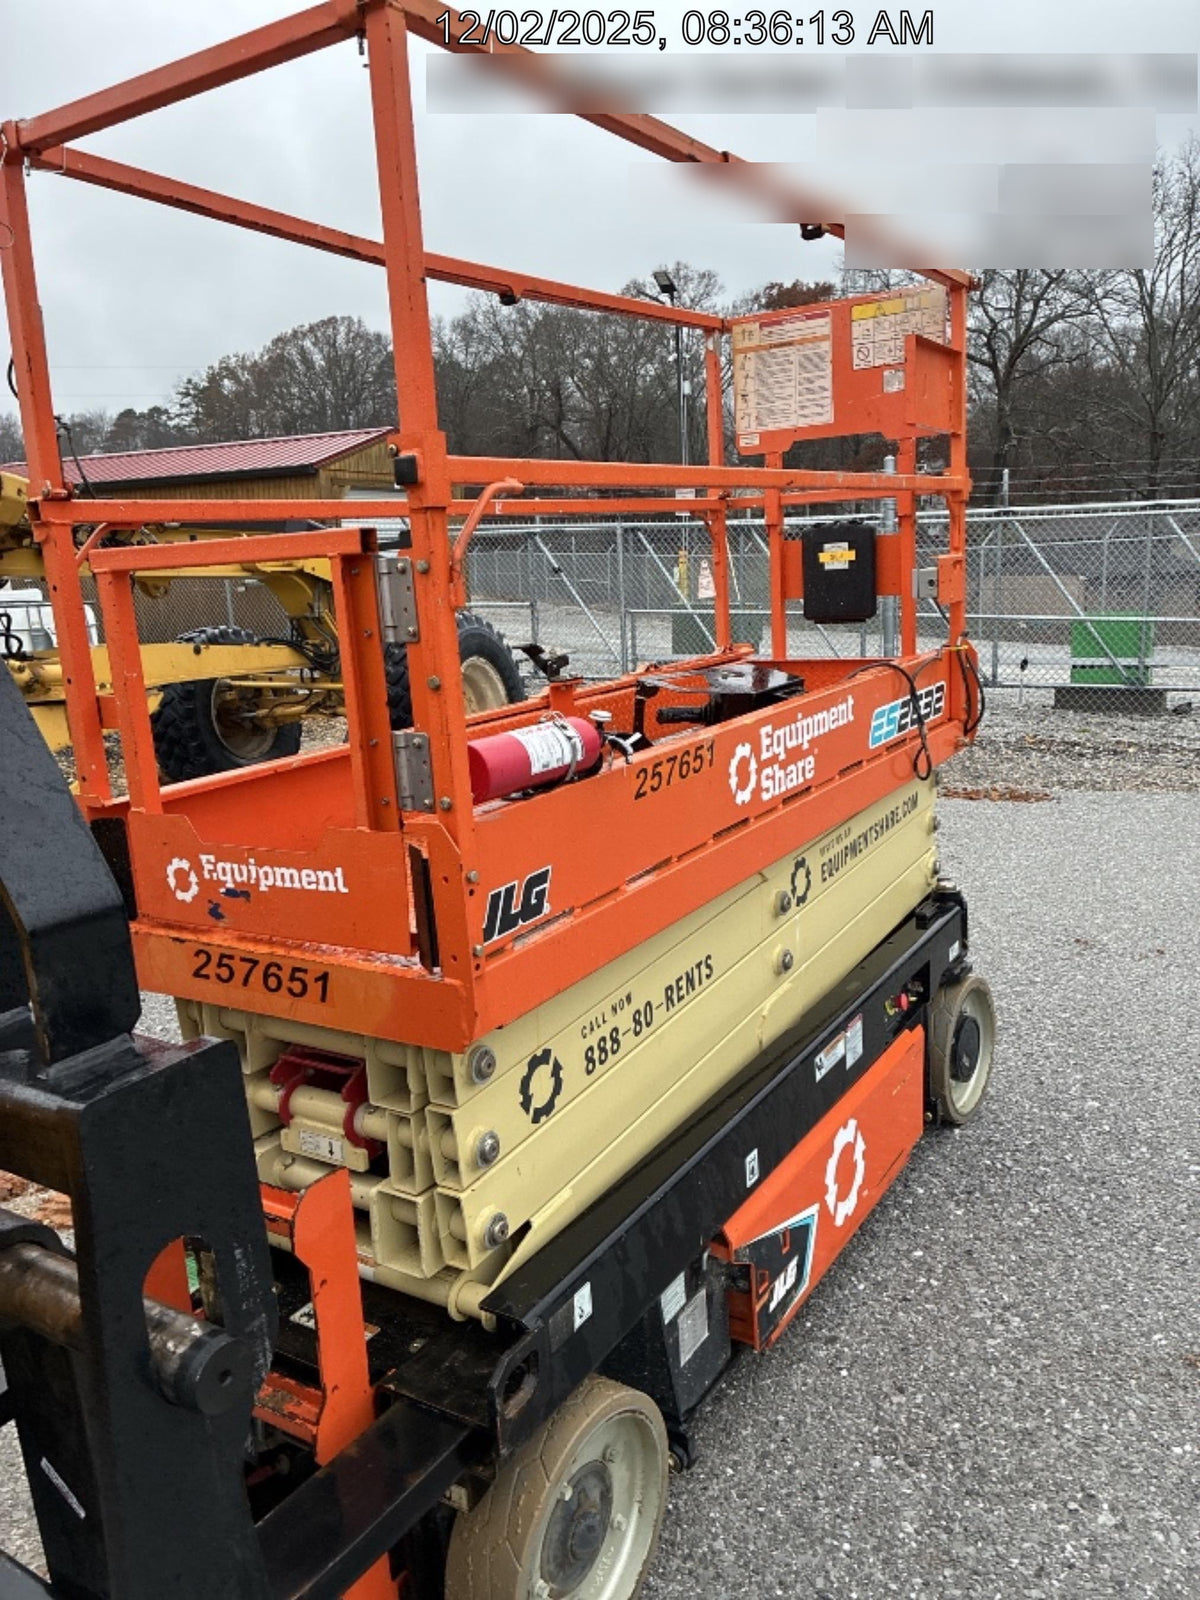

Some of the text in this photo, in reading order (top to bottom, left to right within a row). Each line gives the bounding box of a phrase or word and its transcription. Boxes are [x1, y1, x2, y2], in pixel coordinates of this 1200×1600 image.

[760, 694, 854, 761] Equipment
[634, 739, 716, 801] 257651
[761, 755, 815, 802] Share
[820, 790, 919, 884] EQUIPMENTSHARE.COM
[199, 854, 349, 893] Equipment
[482, 865, 552, 946] JLG
[192, 949, 330, 1003] 257651
[581, 991, 632, 1039] CALL NOW
[584, 953, 714, 1076] 888-80-RENTS
[769, 1254, 799, 1313] JLG
